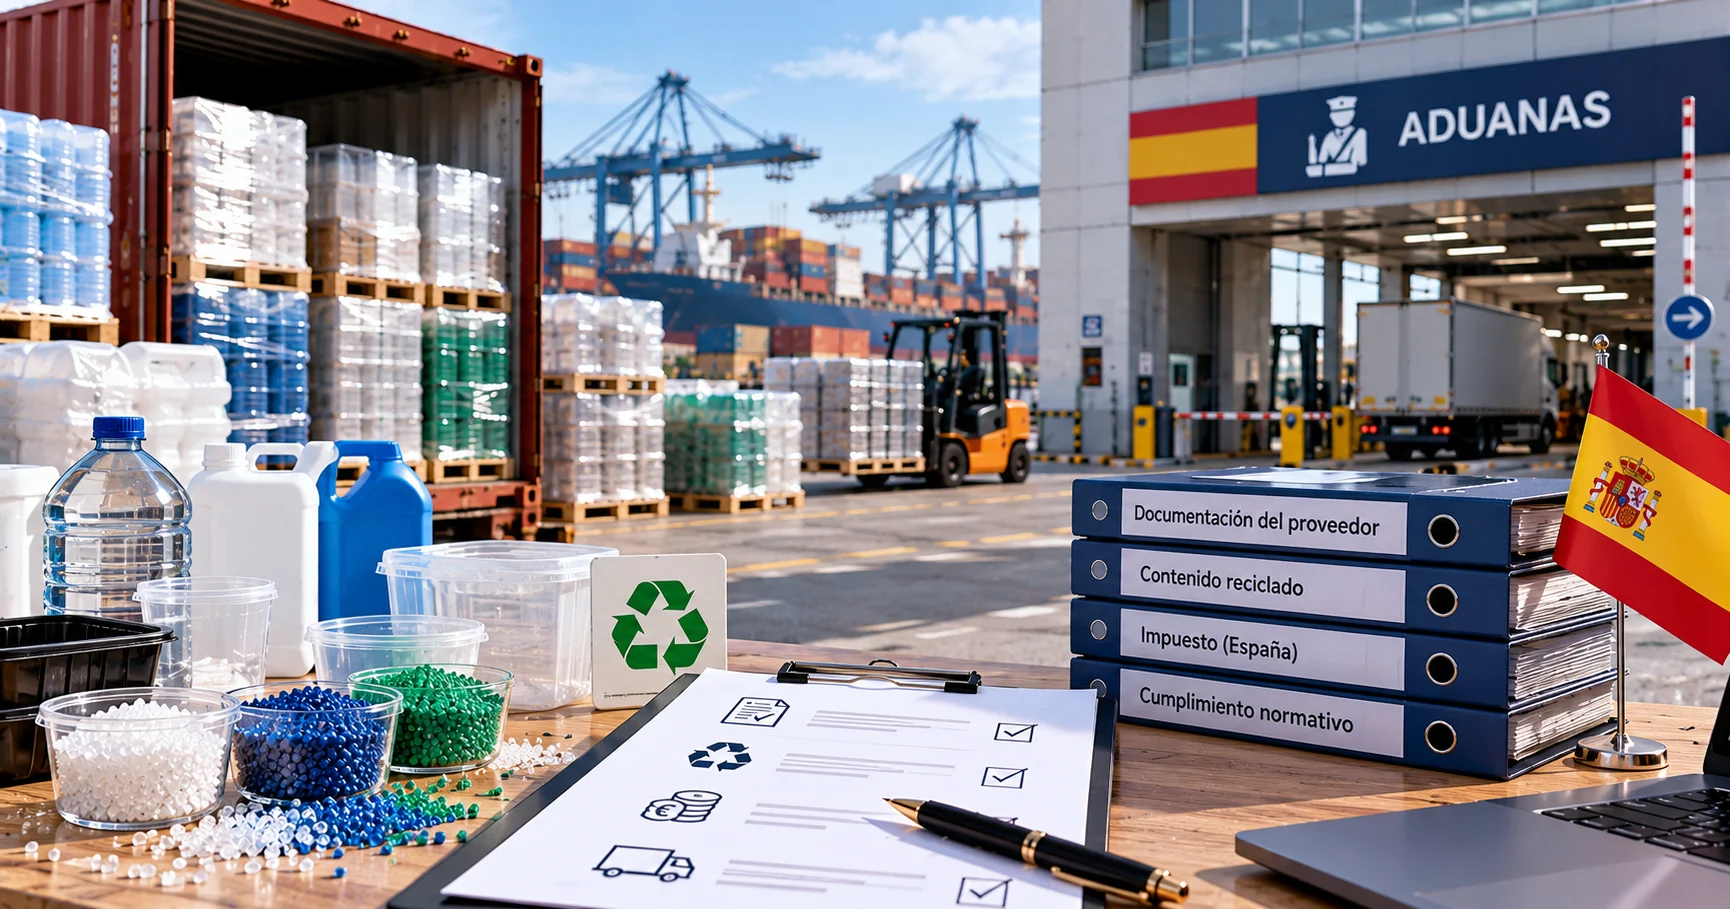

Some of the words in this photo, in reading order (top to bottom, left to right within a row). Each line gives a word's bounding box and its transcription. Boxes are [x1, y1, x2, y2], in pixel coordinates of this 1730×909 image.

[1398, 90, 1611, 147] ADUANAS
[1134, 504, 1253, 528] Documentación
[1257, 510, 1283, 530] del
[1288, 516, 1381, 536] proveedor
[1139, 565, 1222, 589] Contenido
[1226, 573, 1304, 597] reciclado
[1140, 626, 1218, 653] Impuesto
[1223, 635, 1298, 664] (España)
[1138, 686, 1255, 718] Cumplimiento
[1259, 707, 1354, 734] normativo
